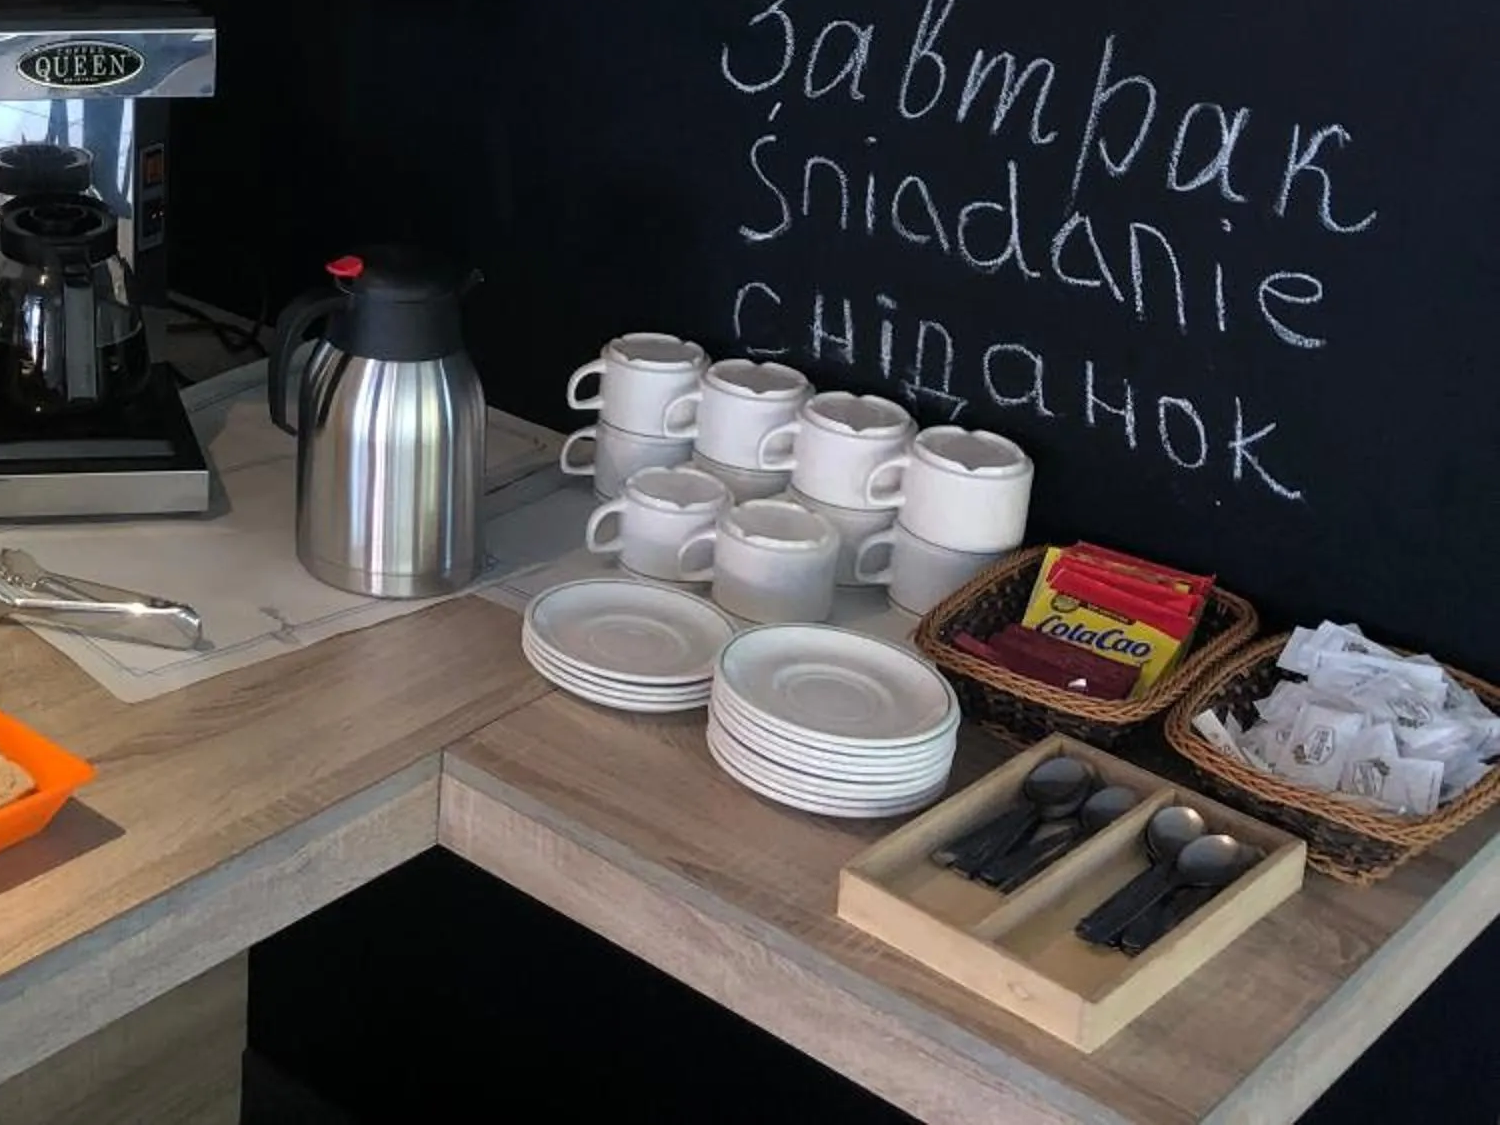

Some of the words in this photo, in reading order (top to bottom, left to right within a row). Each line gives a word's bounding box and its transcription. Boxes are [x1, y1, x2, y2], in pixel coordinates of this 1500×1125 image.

[35, 55, 126, 81] QUEEN
[739, 101, 1326, 348] Śniadanie
[1035, 615, 1152, 658] ColaCao
